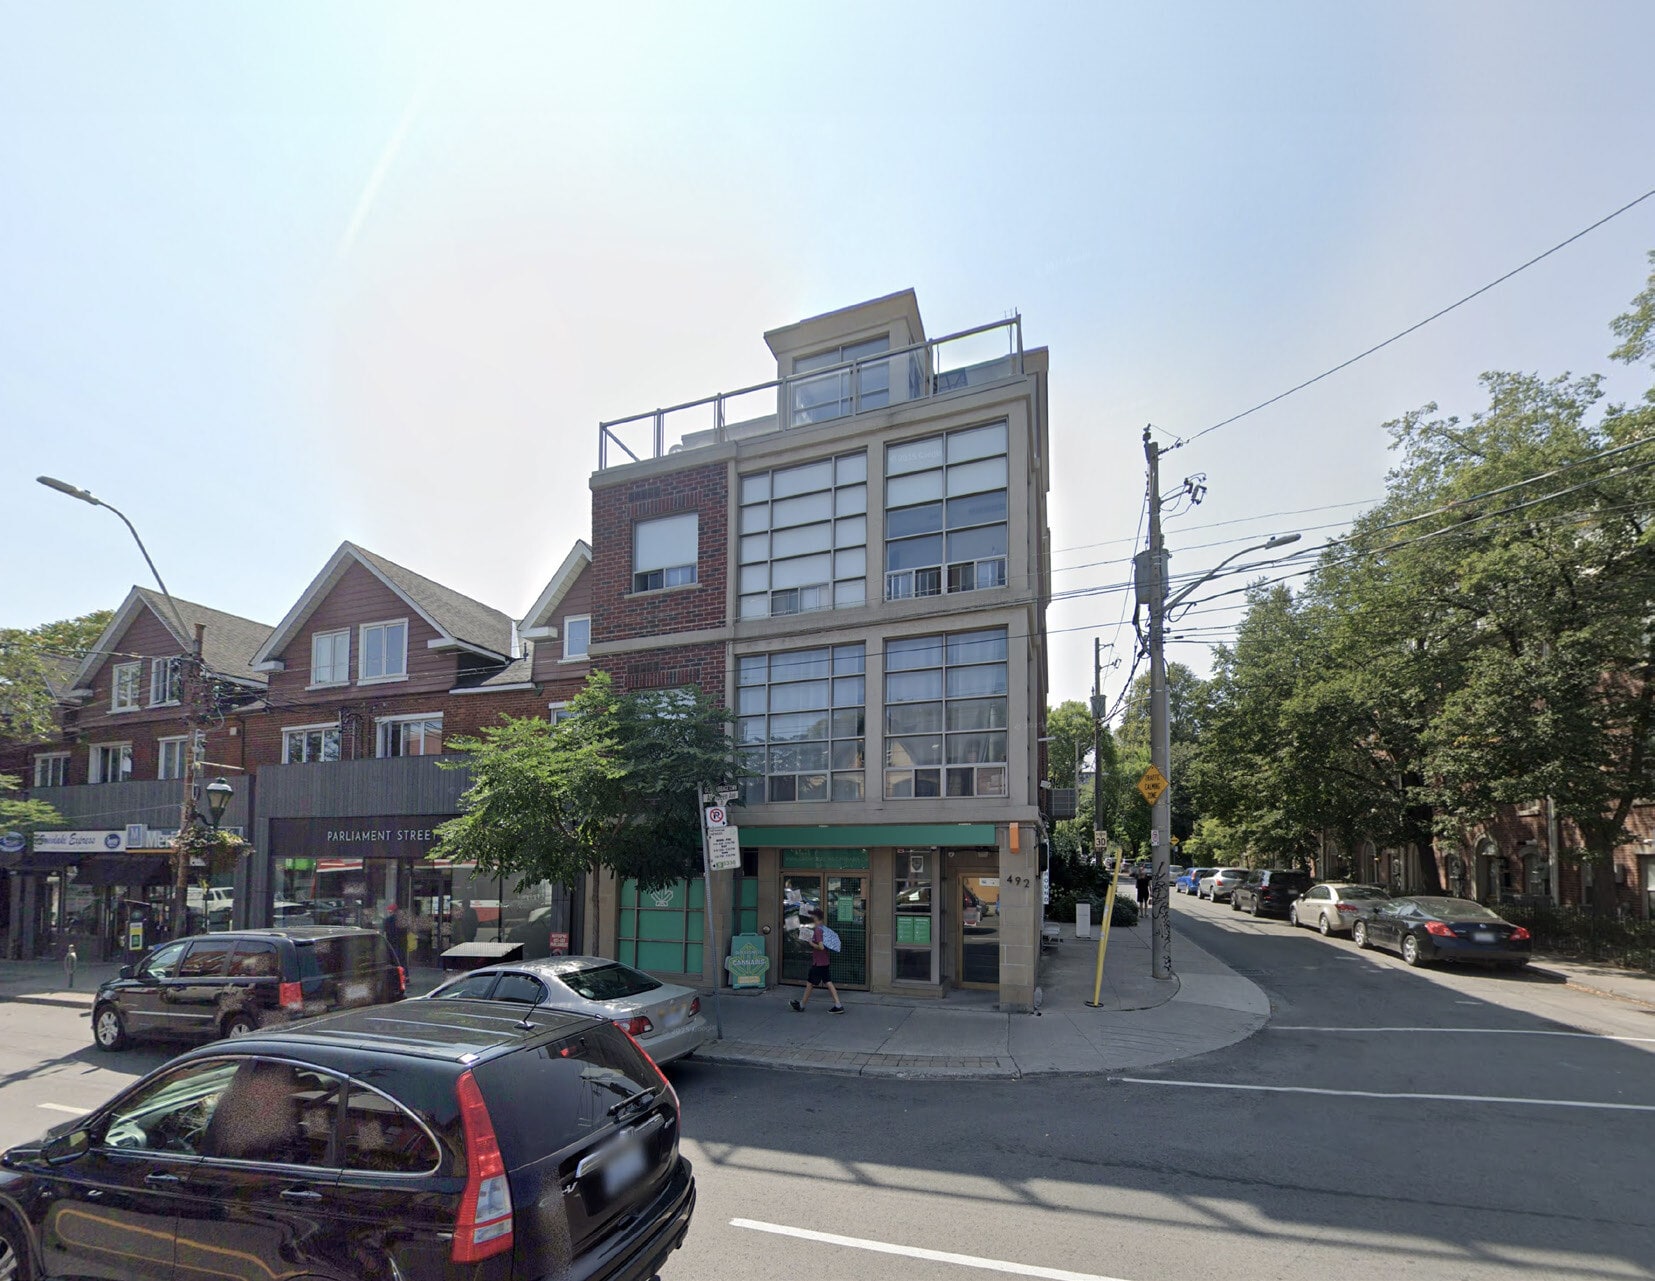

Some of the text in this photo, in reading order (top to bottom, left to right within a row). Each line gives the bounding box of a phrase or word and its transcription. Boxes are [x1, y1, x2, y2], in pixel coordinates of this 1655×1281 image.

[1144, 783, 1161, 791] CALMING
[327, 830, 392, 842] PARLIAMENT
[1095, 837, 1106, 846] 30
[1006, 874, 1030, 889] 492
[732, 958, 766, 967] CANNABIS
